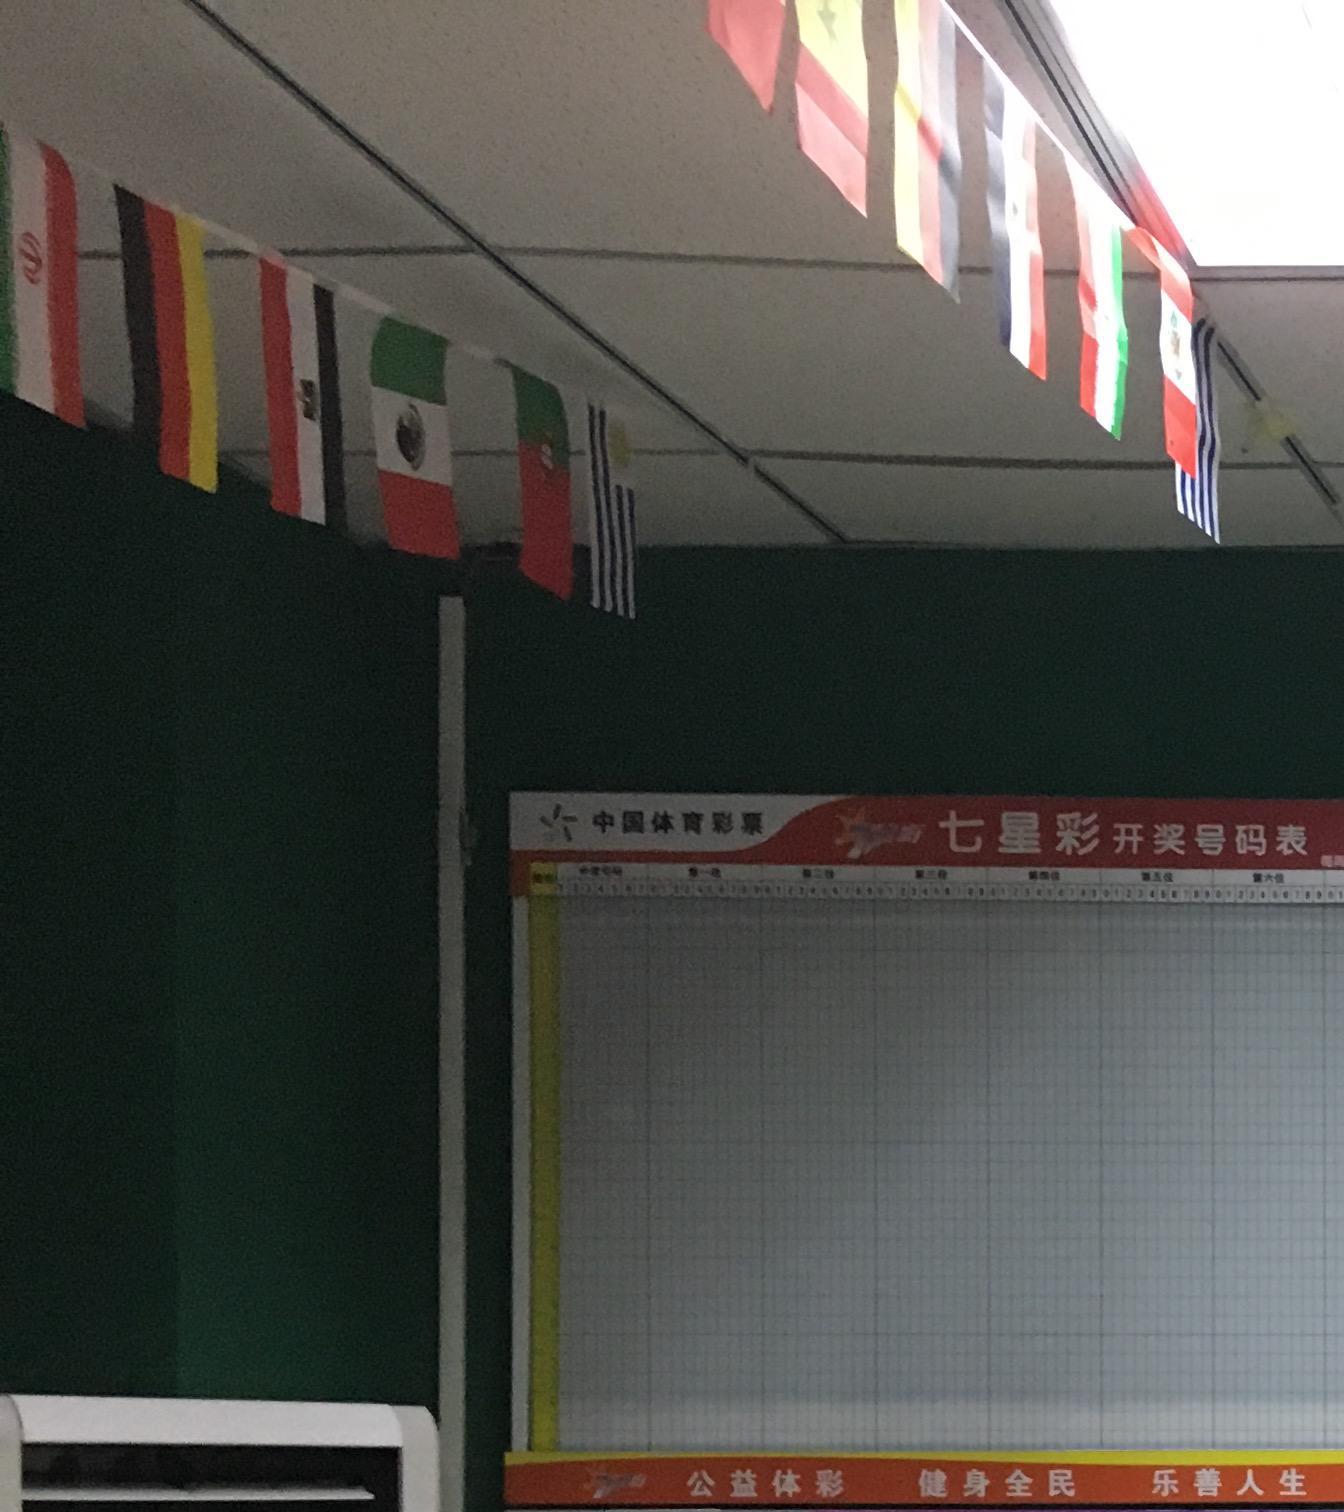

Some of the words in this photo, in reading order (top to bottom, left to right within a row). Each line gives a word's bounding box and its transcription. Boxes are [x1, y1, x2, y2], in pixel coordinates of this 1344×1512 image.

[592, 810, 763, 835] 中国体育彩票
[685, 1470, 847, 1497] 公益体彩
[917, 1469, 1077, 1498] 健身全民
[1151, 1467, 1308, 1497] 乐善人生
